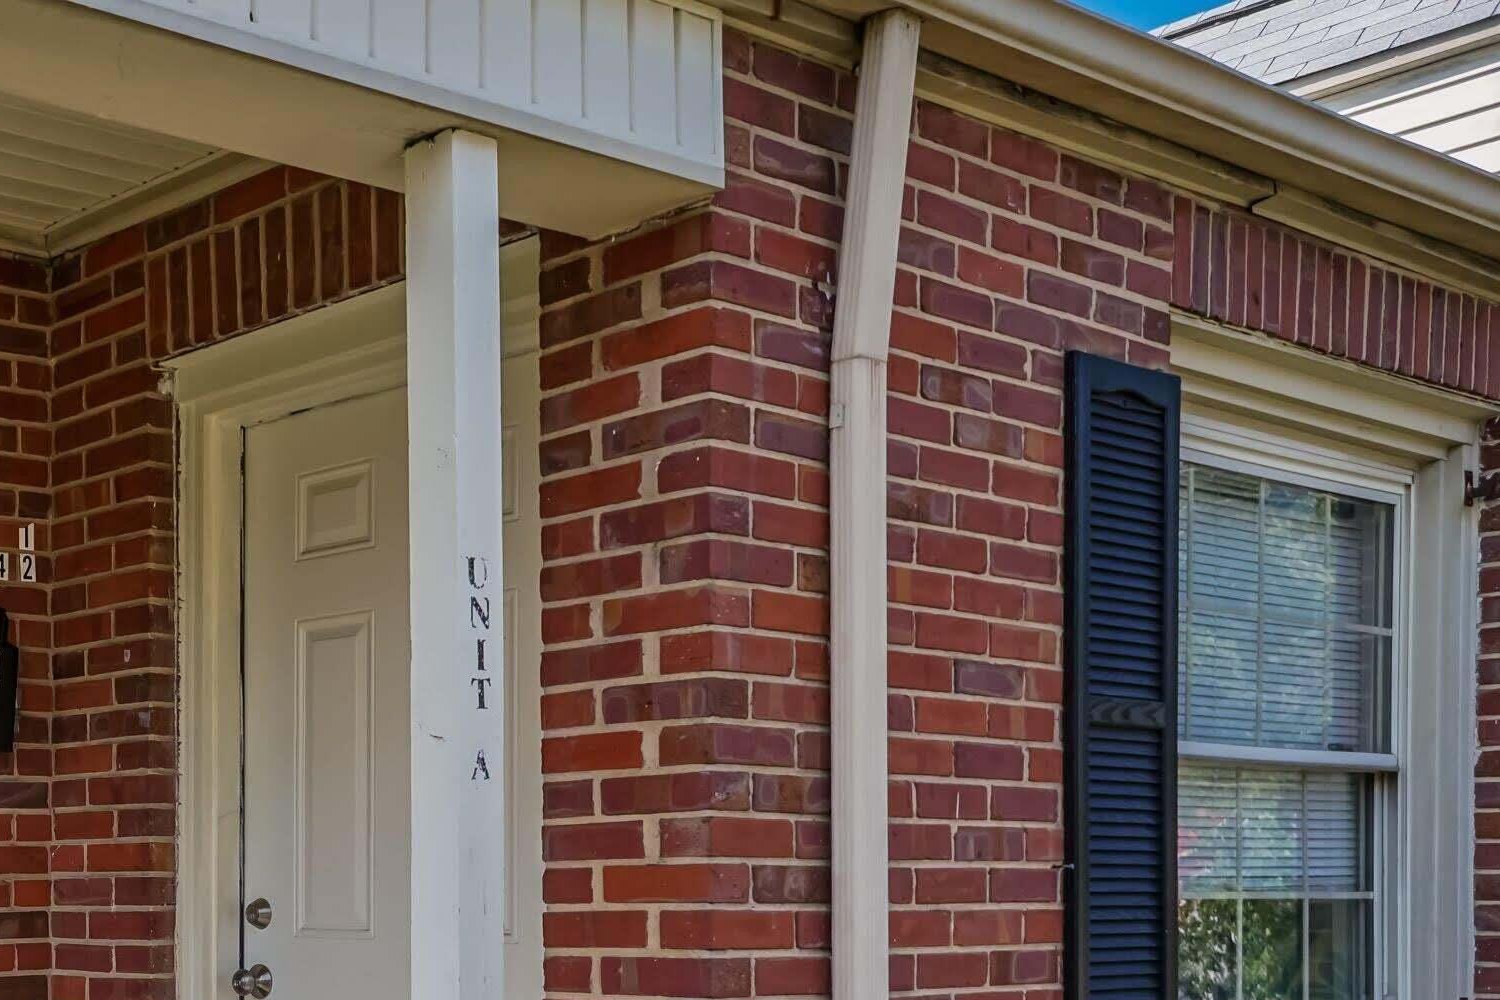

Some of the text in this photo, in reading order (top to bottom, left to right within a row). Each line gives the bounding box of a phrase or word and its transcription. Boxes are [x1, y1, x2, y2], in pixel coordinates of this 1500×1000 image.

[22, 555, 33, 581] 2
[466, 556, 492, 781] UNIT A
